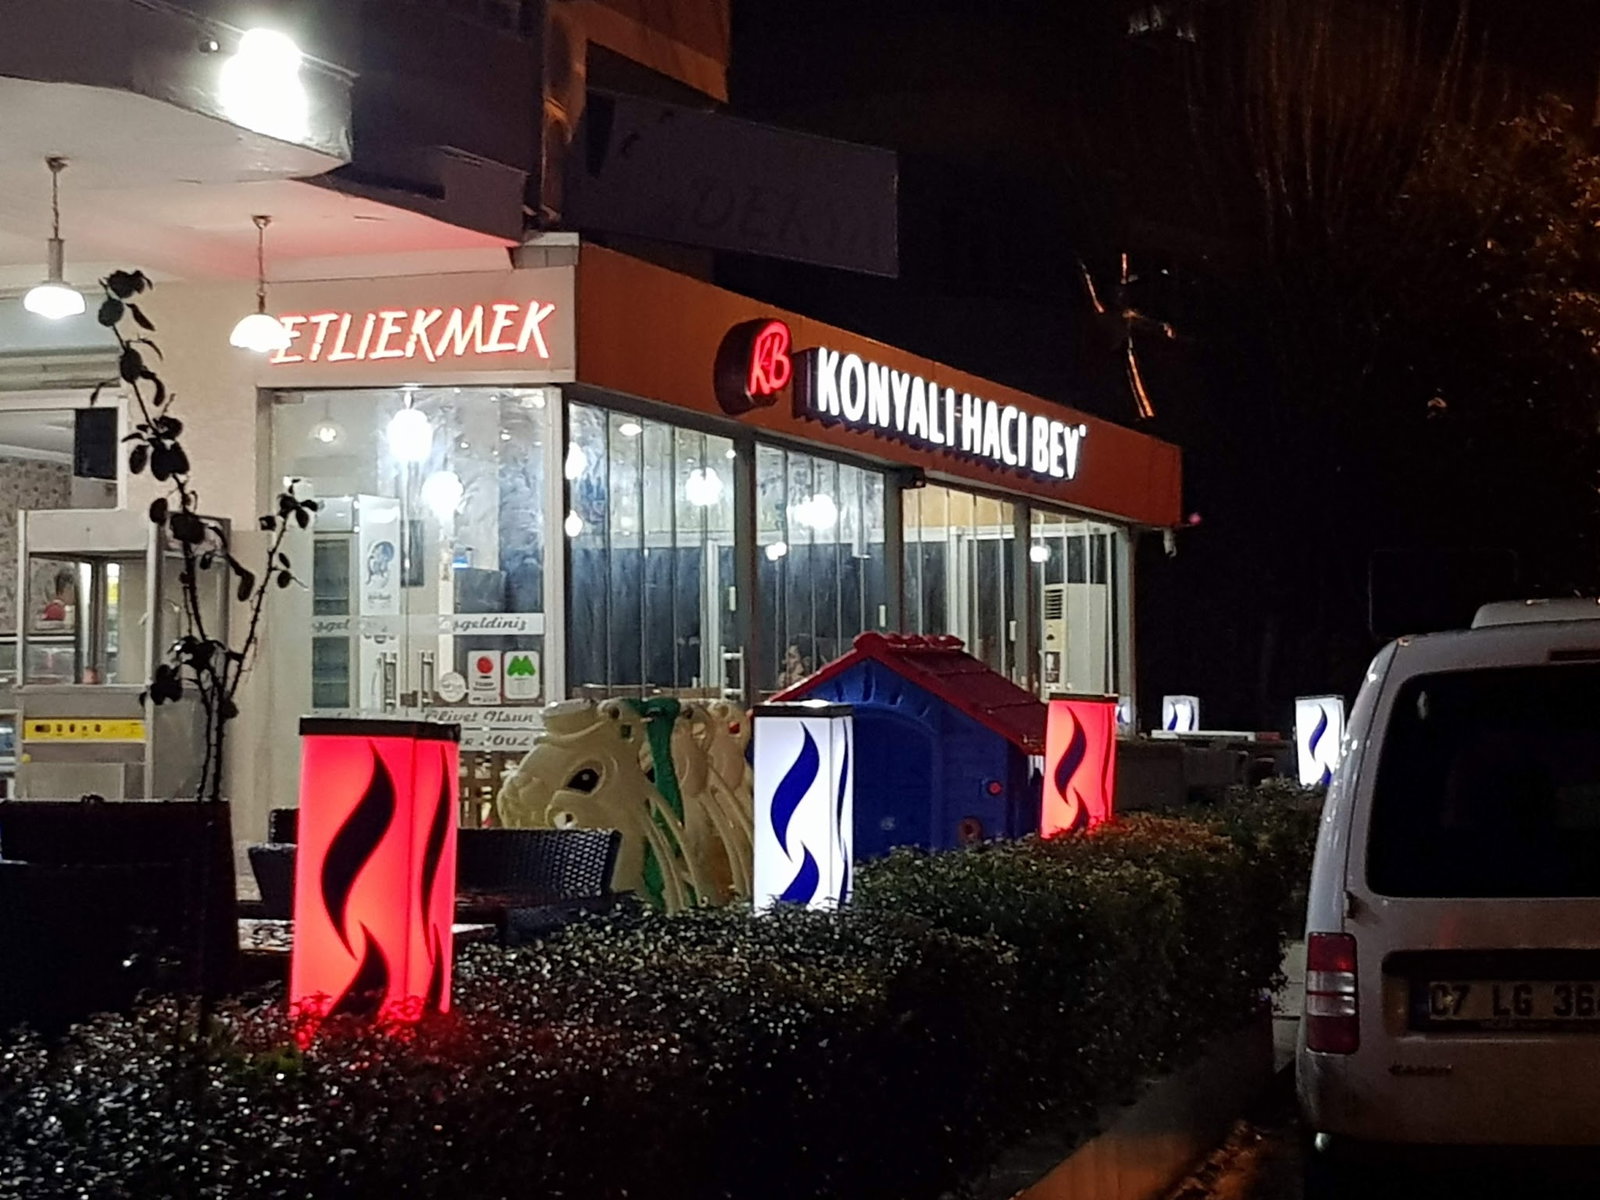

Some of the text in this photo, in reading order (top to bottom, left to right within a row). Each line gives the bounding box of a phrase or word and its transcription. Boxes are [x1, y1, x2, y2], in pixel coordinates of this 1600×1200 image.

[816, 346, 956, 447] KONYALI
[961, 392, 1028, 467] HACI
[1492, 984, 1532, 1016] LG
[1553, 983, 1600, 1017] 36
